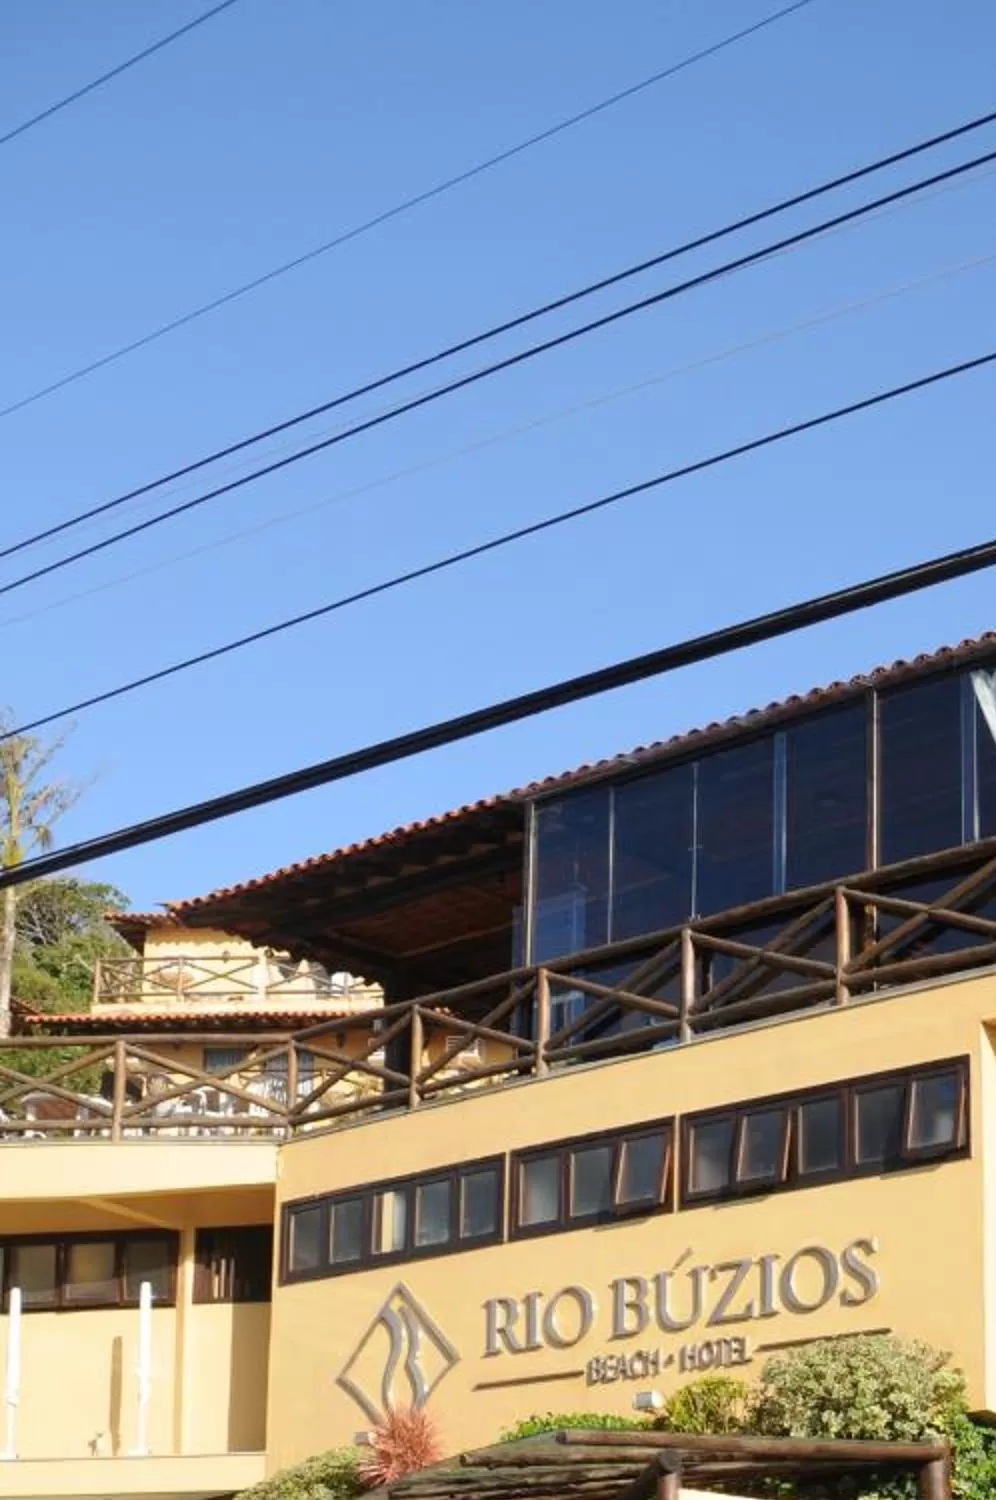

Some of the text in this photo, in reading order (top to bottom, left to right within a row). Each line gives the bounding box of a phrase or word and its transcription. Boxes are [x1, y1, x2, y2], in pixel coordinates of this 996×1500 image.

[481, 1237, 880, 1359] RIO BÚZIOS
[586, 1349, 661, 1386] BEACH
[679, 1336, 753, 1373] HOTEL
